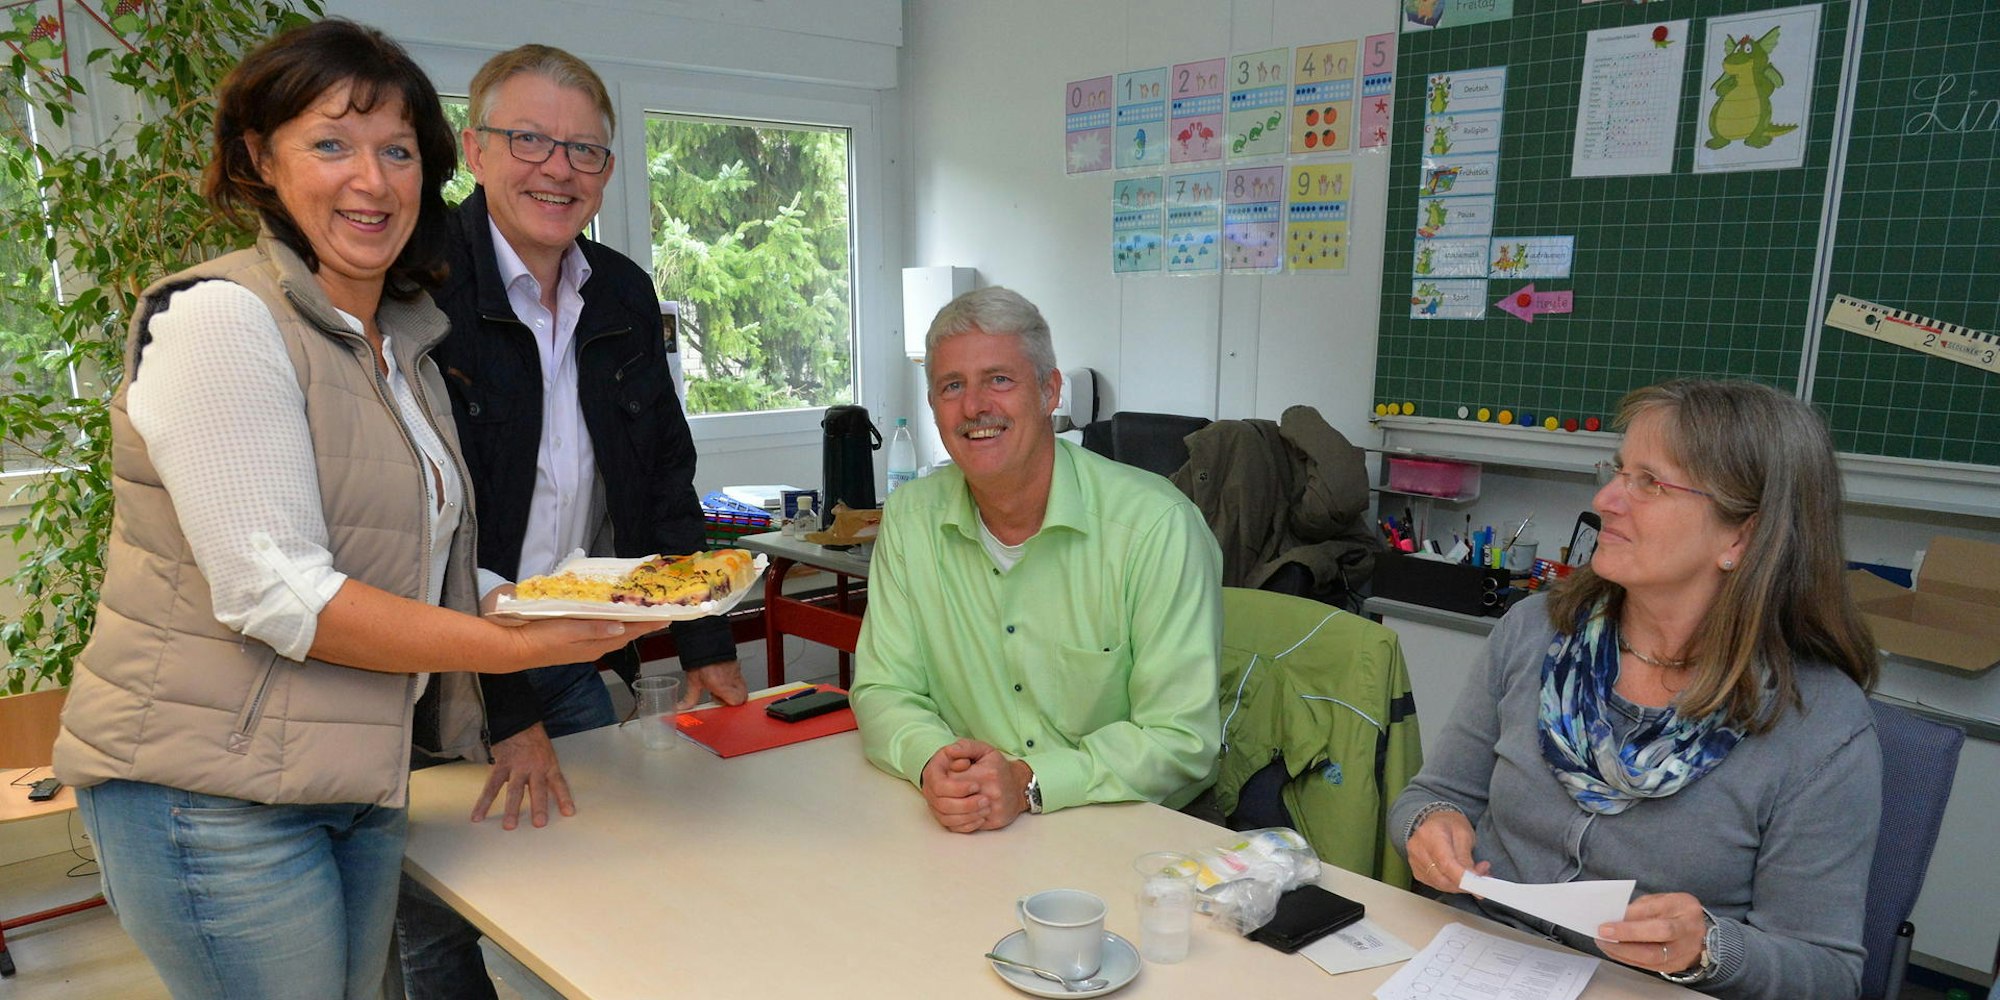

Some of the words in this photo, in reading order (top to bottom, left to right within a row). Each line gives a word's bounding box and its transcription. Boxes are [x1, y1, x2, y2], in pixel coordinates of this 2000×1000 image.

[1302, 51, 1315, 76] 4
[1371, 40, 1387, 67] 5
[1178, 70, 1190, 93] 2
[1237, 60, 1250, 85] 3
[1071, 87, 1082, 107] 0
[1125, 77, 1133, 100] 1
[1463, 83, 1489, 94] Deutsch
[1463, 125, 1489, 136] Religion
[1459, 167, 1489, 177] Frühstück
[1175, 180, 1187, 201] 7
[1233, 175, 1245, 197] 8
[1298, 172, 1310, 195] 9
[1119, 185, 1130, 205] 6
[1536, 295, 1568, 309] heute
[1874, 320, 1881, 332] 1
[1923, 334, 1936, 347] 2
[1982, 350, 1995, 363] 3
